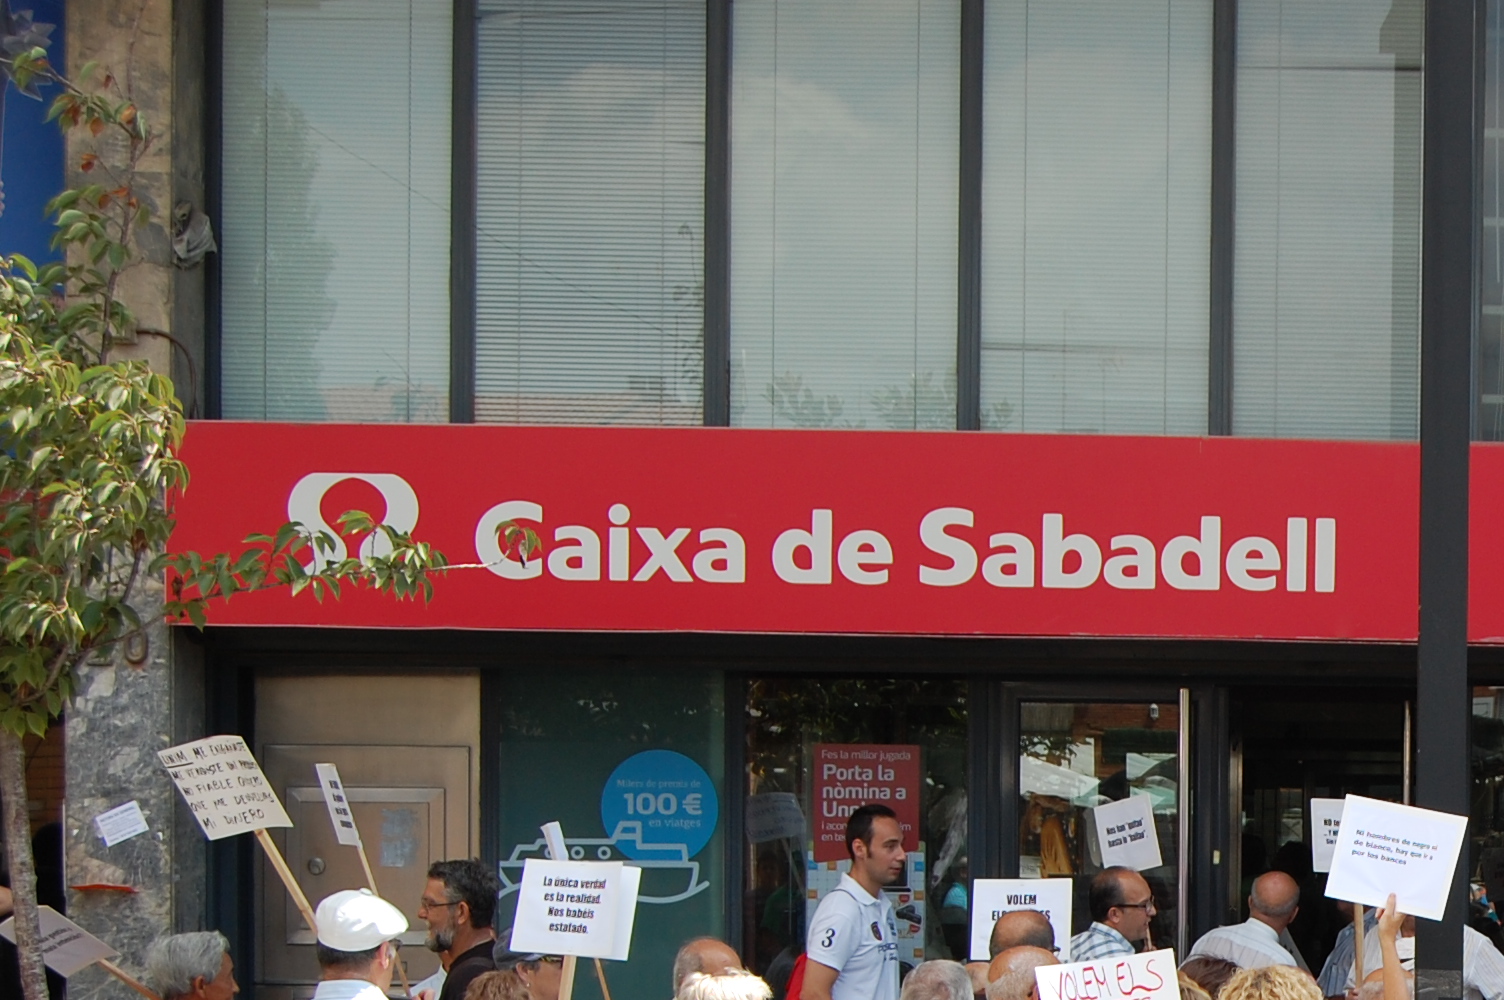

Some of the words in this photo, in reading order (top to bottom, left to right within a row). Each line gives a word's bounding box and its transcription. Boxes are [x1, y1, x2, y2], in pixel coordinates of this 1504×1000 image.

[475, 500, 746, 583] Caixa
[771, 508, 894, 585] de
[919, 506, 1337, 594] Sabadell
[192, 745, 208, 760] ME
[821, 749, 838, 759] Fes
[839, 750, 849, 759] la
[851, 750, 878, 759] millor
[880, 750, 911, 762] jugada
[823, 763, 873, 781] Porta
[878, 764, 895, 781] la
[196, 778, 234, 795] FIABLE
[690, 779, 701, 788] de
[822, 782, 891, 800] nòmina
[895, 787, 907, 800] a
[623, 792, 678, 815] 100
[682, 792, 702, 815] €
[223, 808, 265, 824] DINERO
[648, 819, 662, 828] en
[664, 818, 701, 830] viatges
[543, 875, 553, 887] La
[580, 879, 607, 889] verdad
[543, 892, 554, 902] es
[555, 891, 565, 903] la
[1006, 894, 1037, 906] VOLEM
[547, 906, 564, 917] Nos
[821, 928, 836, 948] 3
[1115, 959, 1164, 996] ELS
